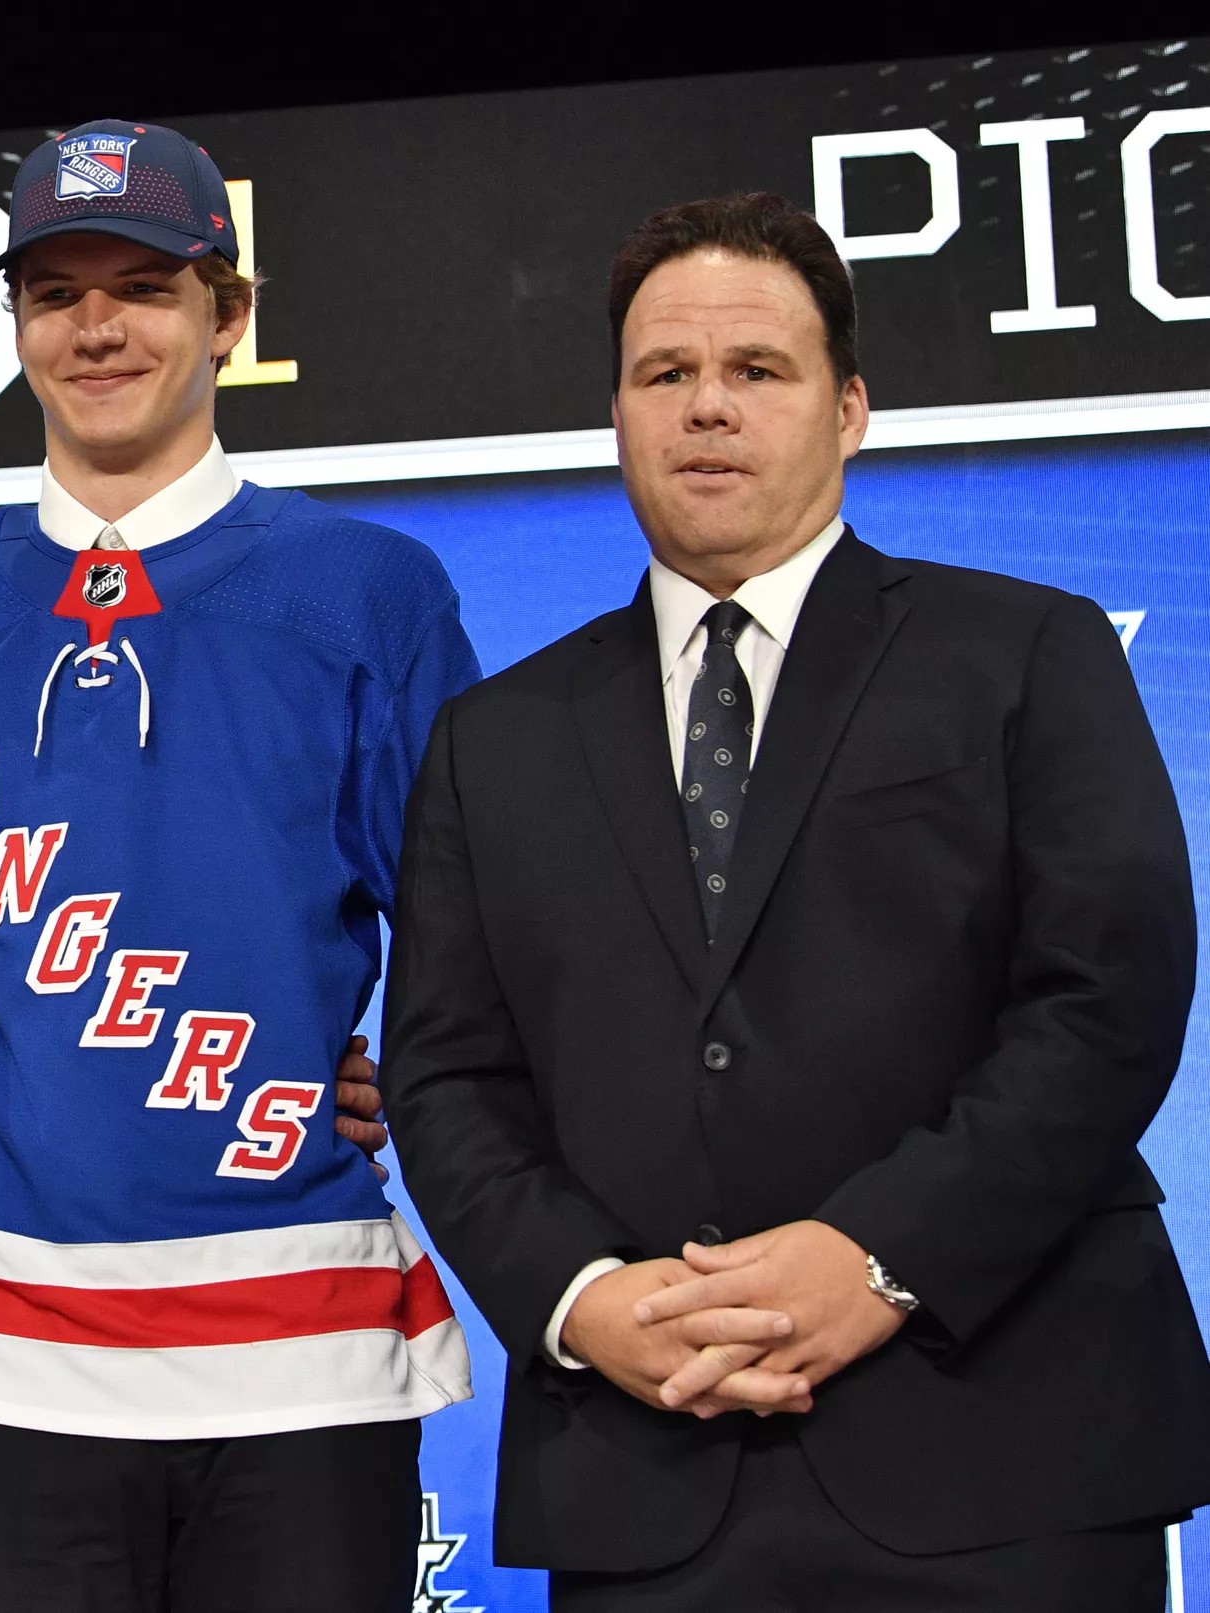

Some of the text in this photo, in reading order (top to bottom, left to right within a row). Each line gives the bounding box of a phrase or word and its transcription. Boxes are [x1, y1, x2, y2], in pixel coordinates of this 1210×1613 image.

[62, 139, 125, 156] NEW YORK
[68, 156, 120, 189] RANGERS
[92, 575, 118, 598] NHL
